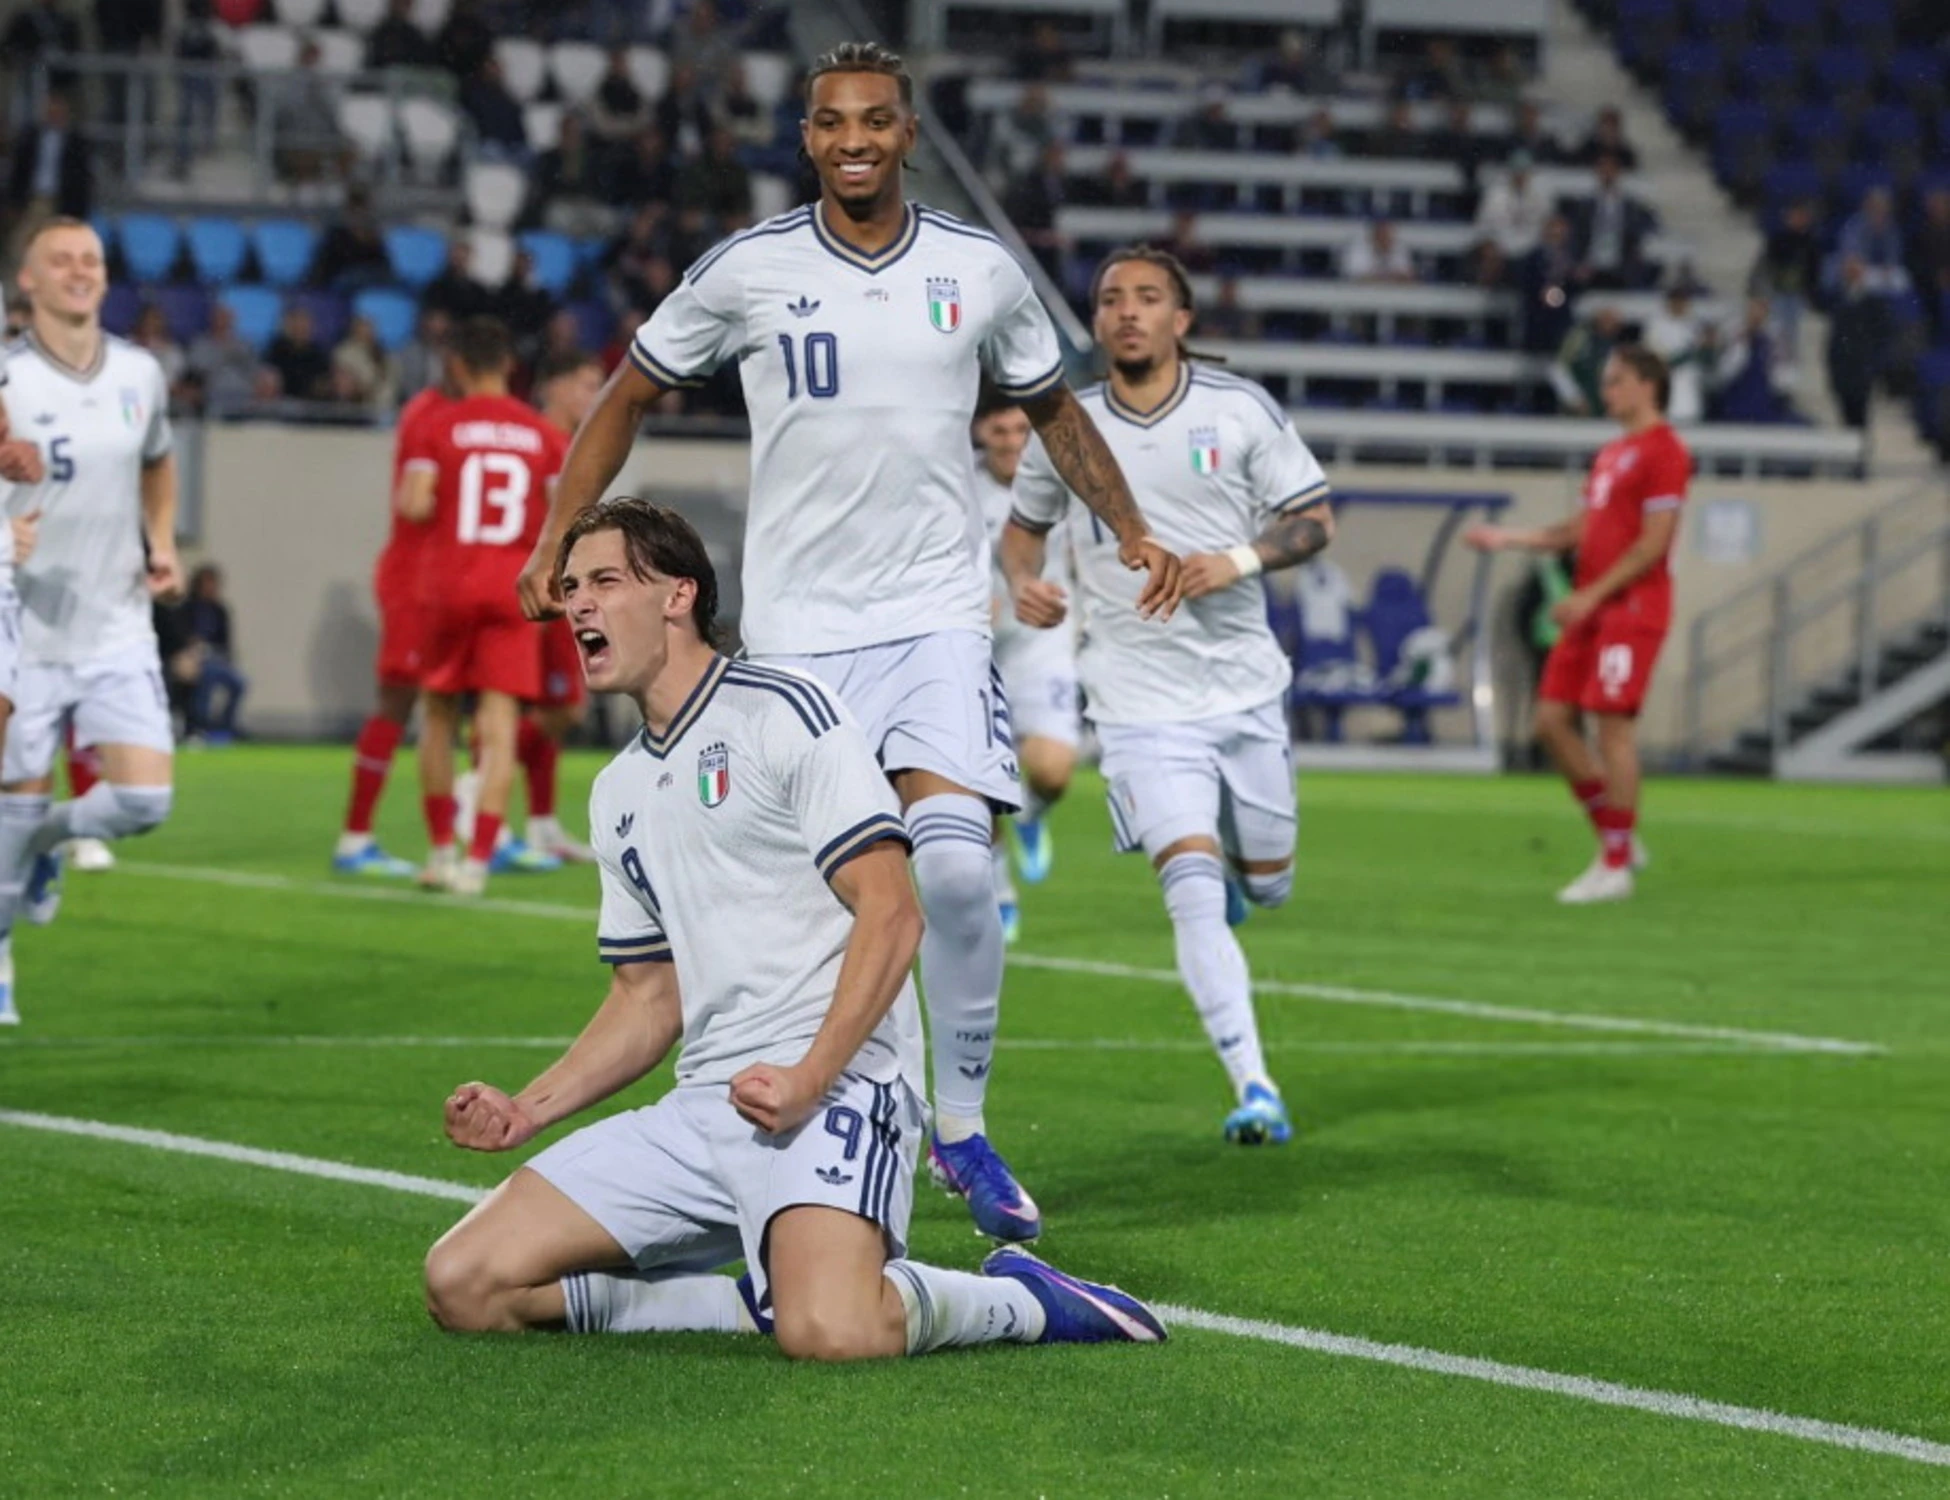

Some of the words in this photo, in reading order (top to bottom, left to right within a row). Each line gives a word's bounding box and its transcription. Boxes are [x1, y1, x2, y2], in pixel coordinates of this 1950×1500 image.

[778, 332, 839, 399] 10
[49, 436, 75, 482] 5
[457, 451, 531, 546] 13
[621, 846, 662, 914] 9
[956, 1030, 991, 1043] ITAL
[824, 1105, 864, 1161] 9
